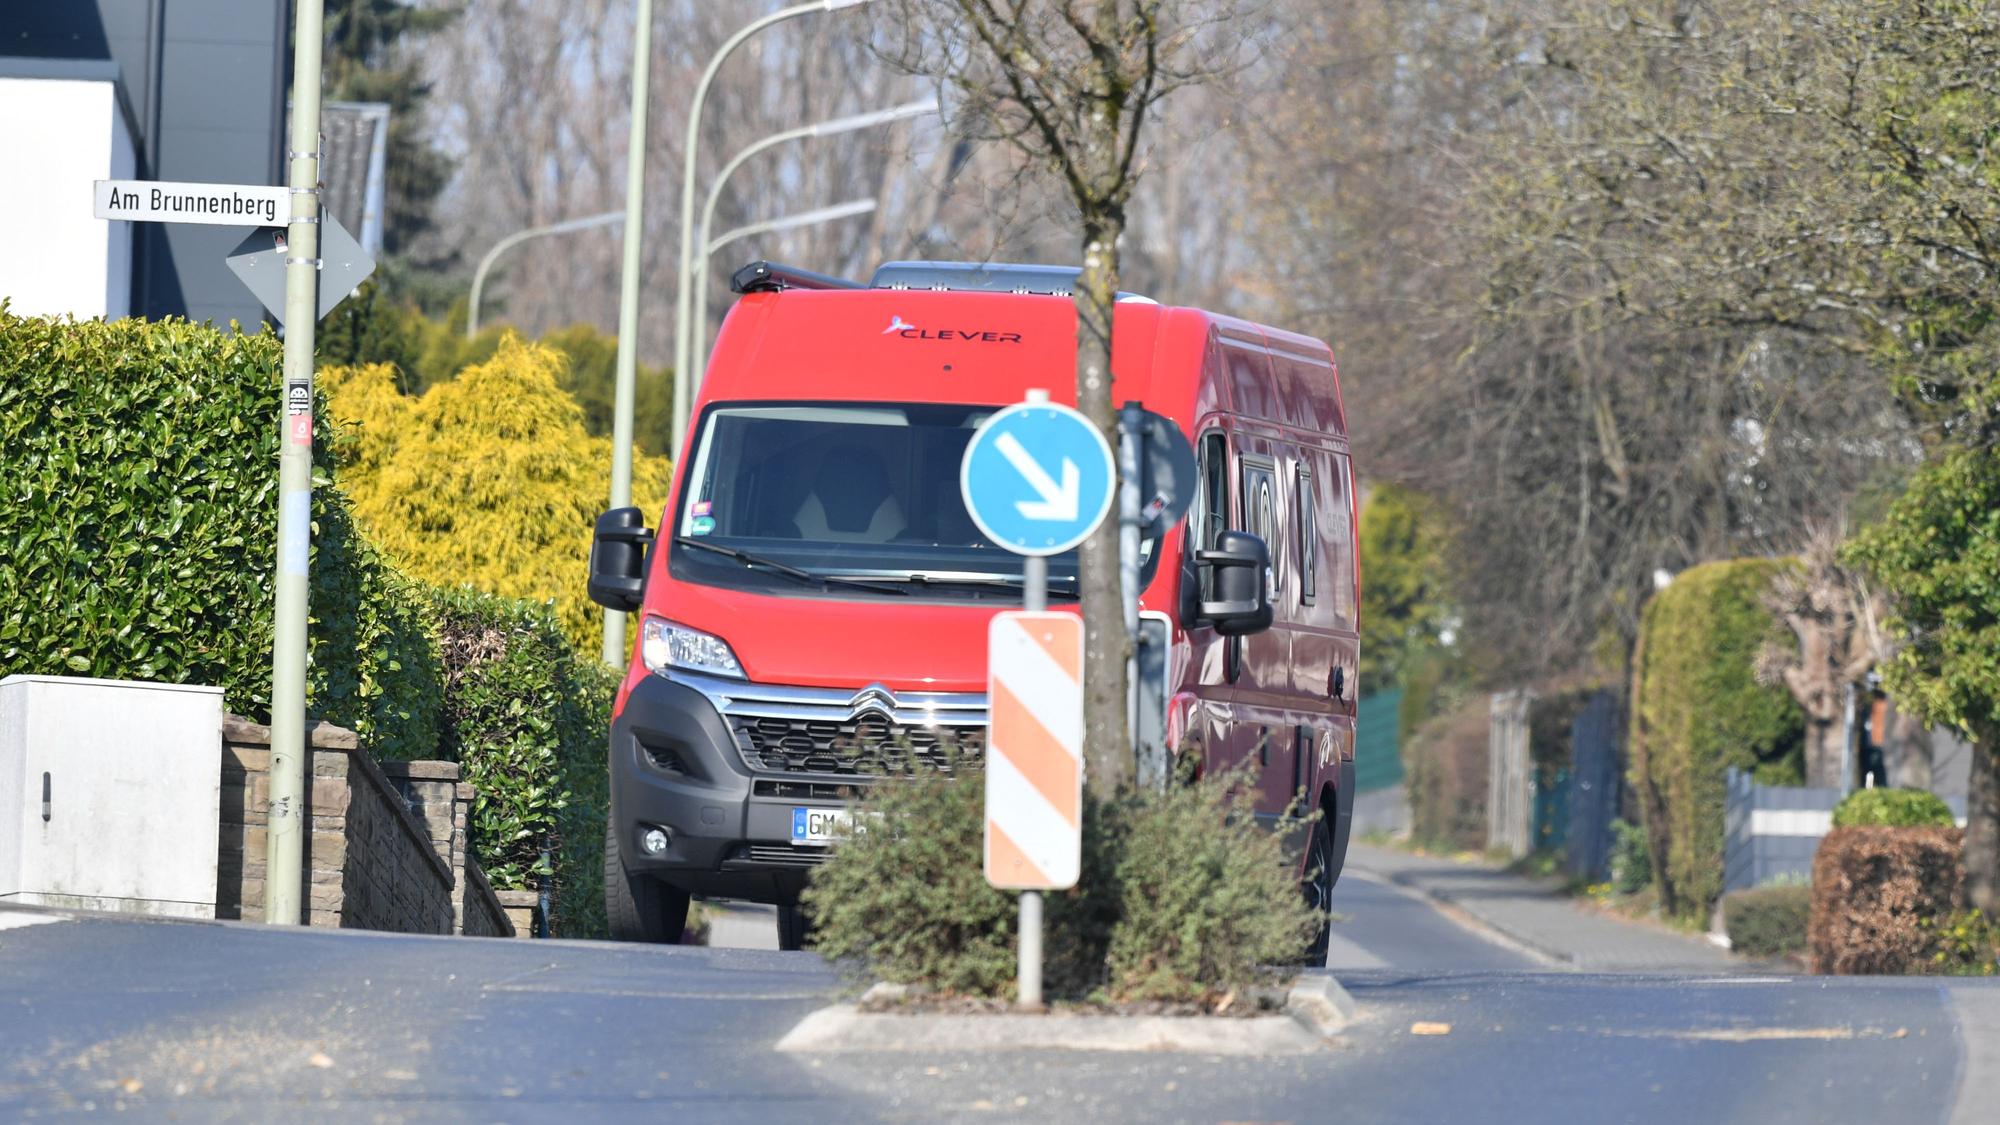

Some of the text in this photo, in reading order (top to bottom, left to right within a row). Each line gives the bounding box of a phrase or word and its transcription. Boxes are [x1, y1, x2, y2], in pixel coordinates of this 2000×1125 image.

[109, 187, 276, 222] Am Brunnenberg
[900, 328, 1022, 343] CLEVER
